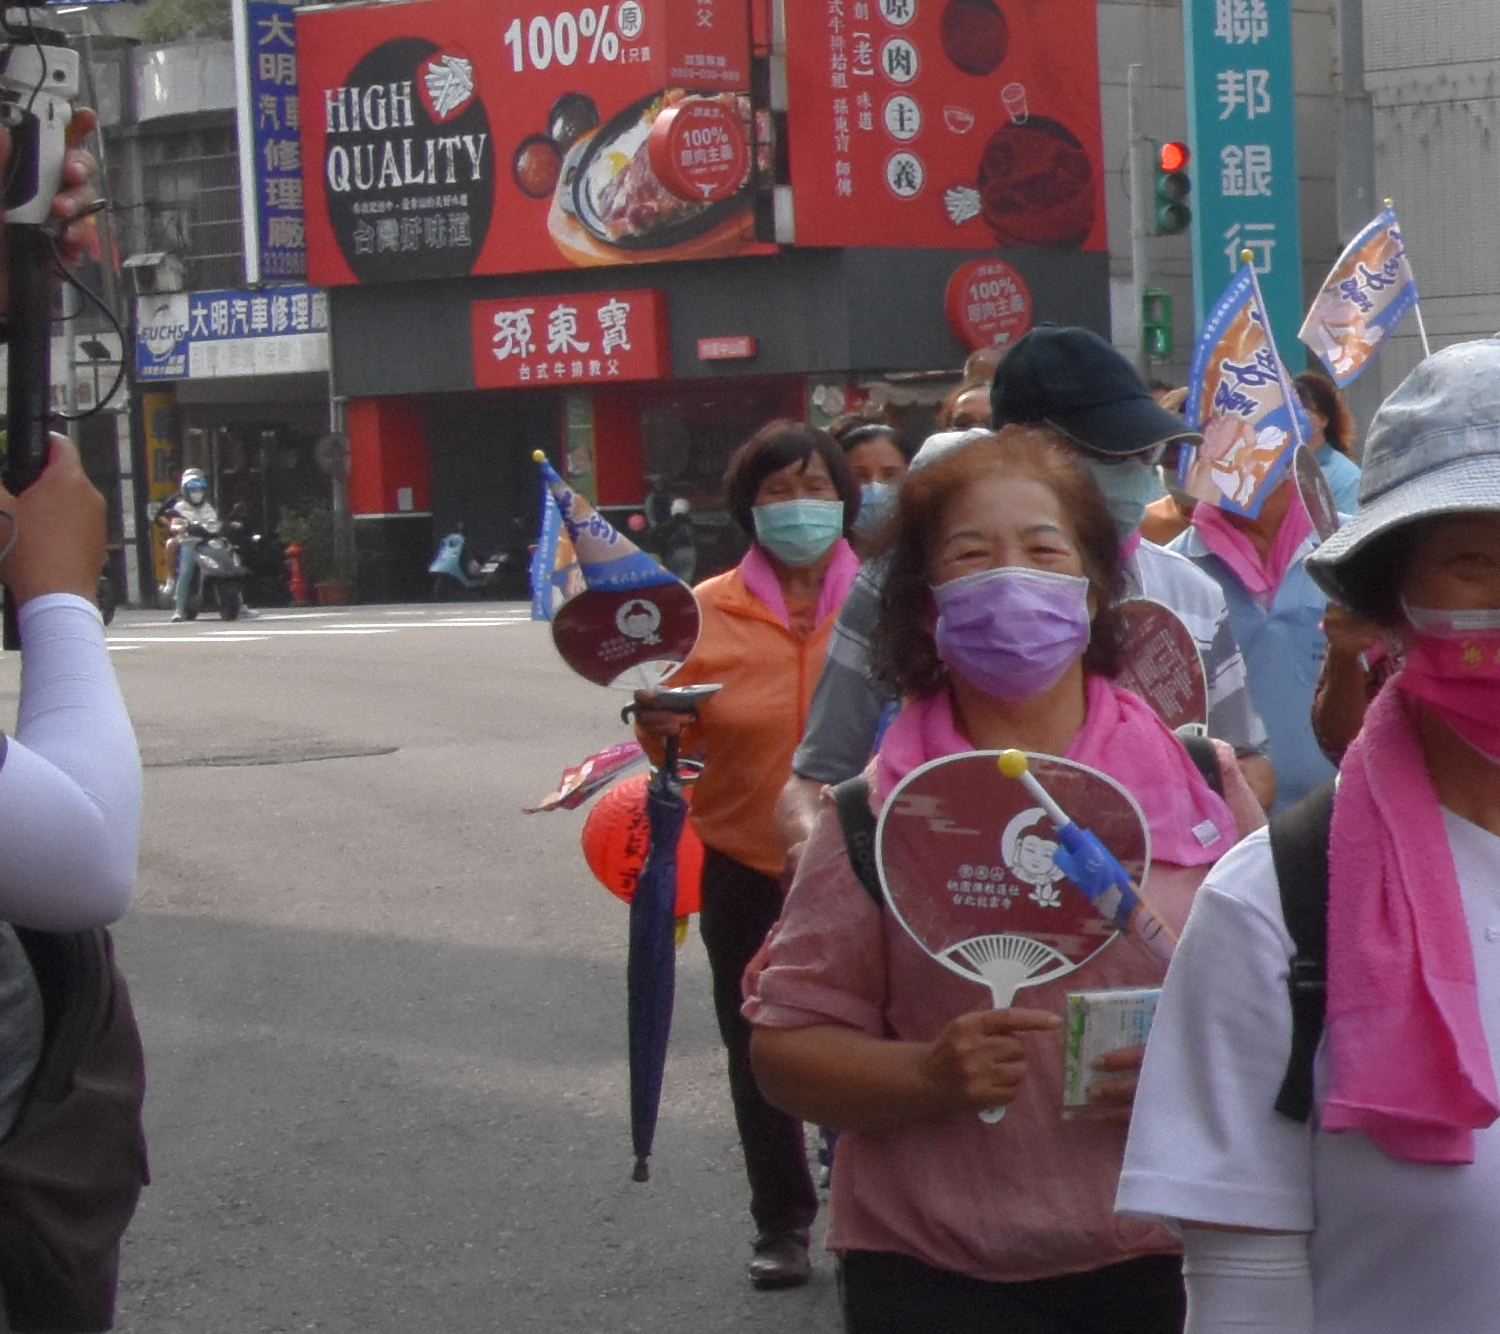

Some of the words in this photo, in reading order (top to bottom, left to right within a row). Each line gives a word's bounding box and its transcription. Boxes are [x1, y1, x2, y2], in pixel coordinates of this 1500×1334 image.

[503, 5, 619, 73] 100%
[323, 80, 415, 134] HIGH
[327, 132, 488, 192] QUALITY
